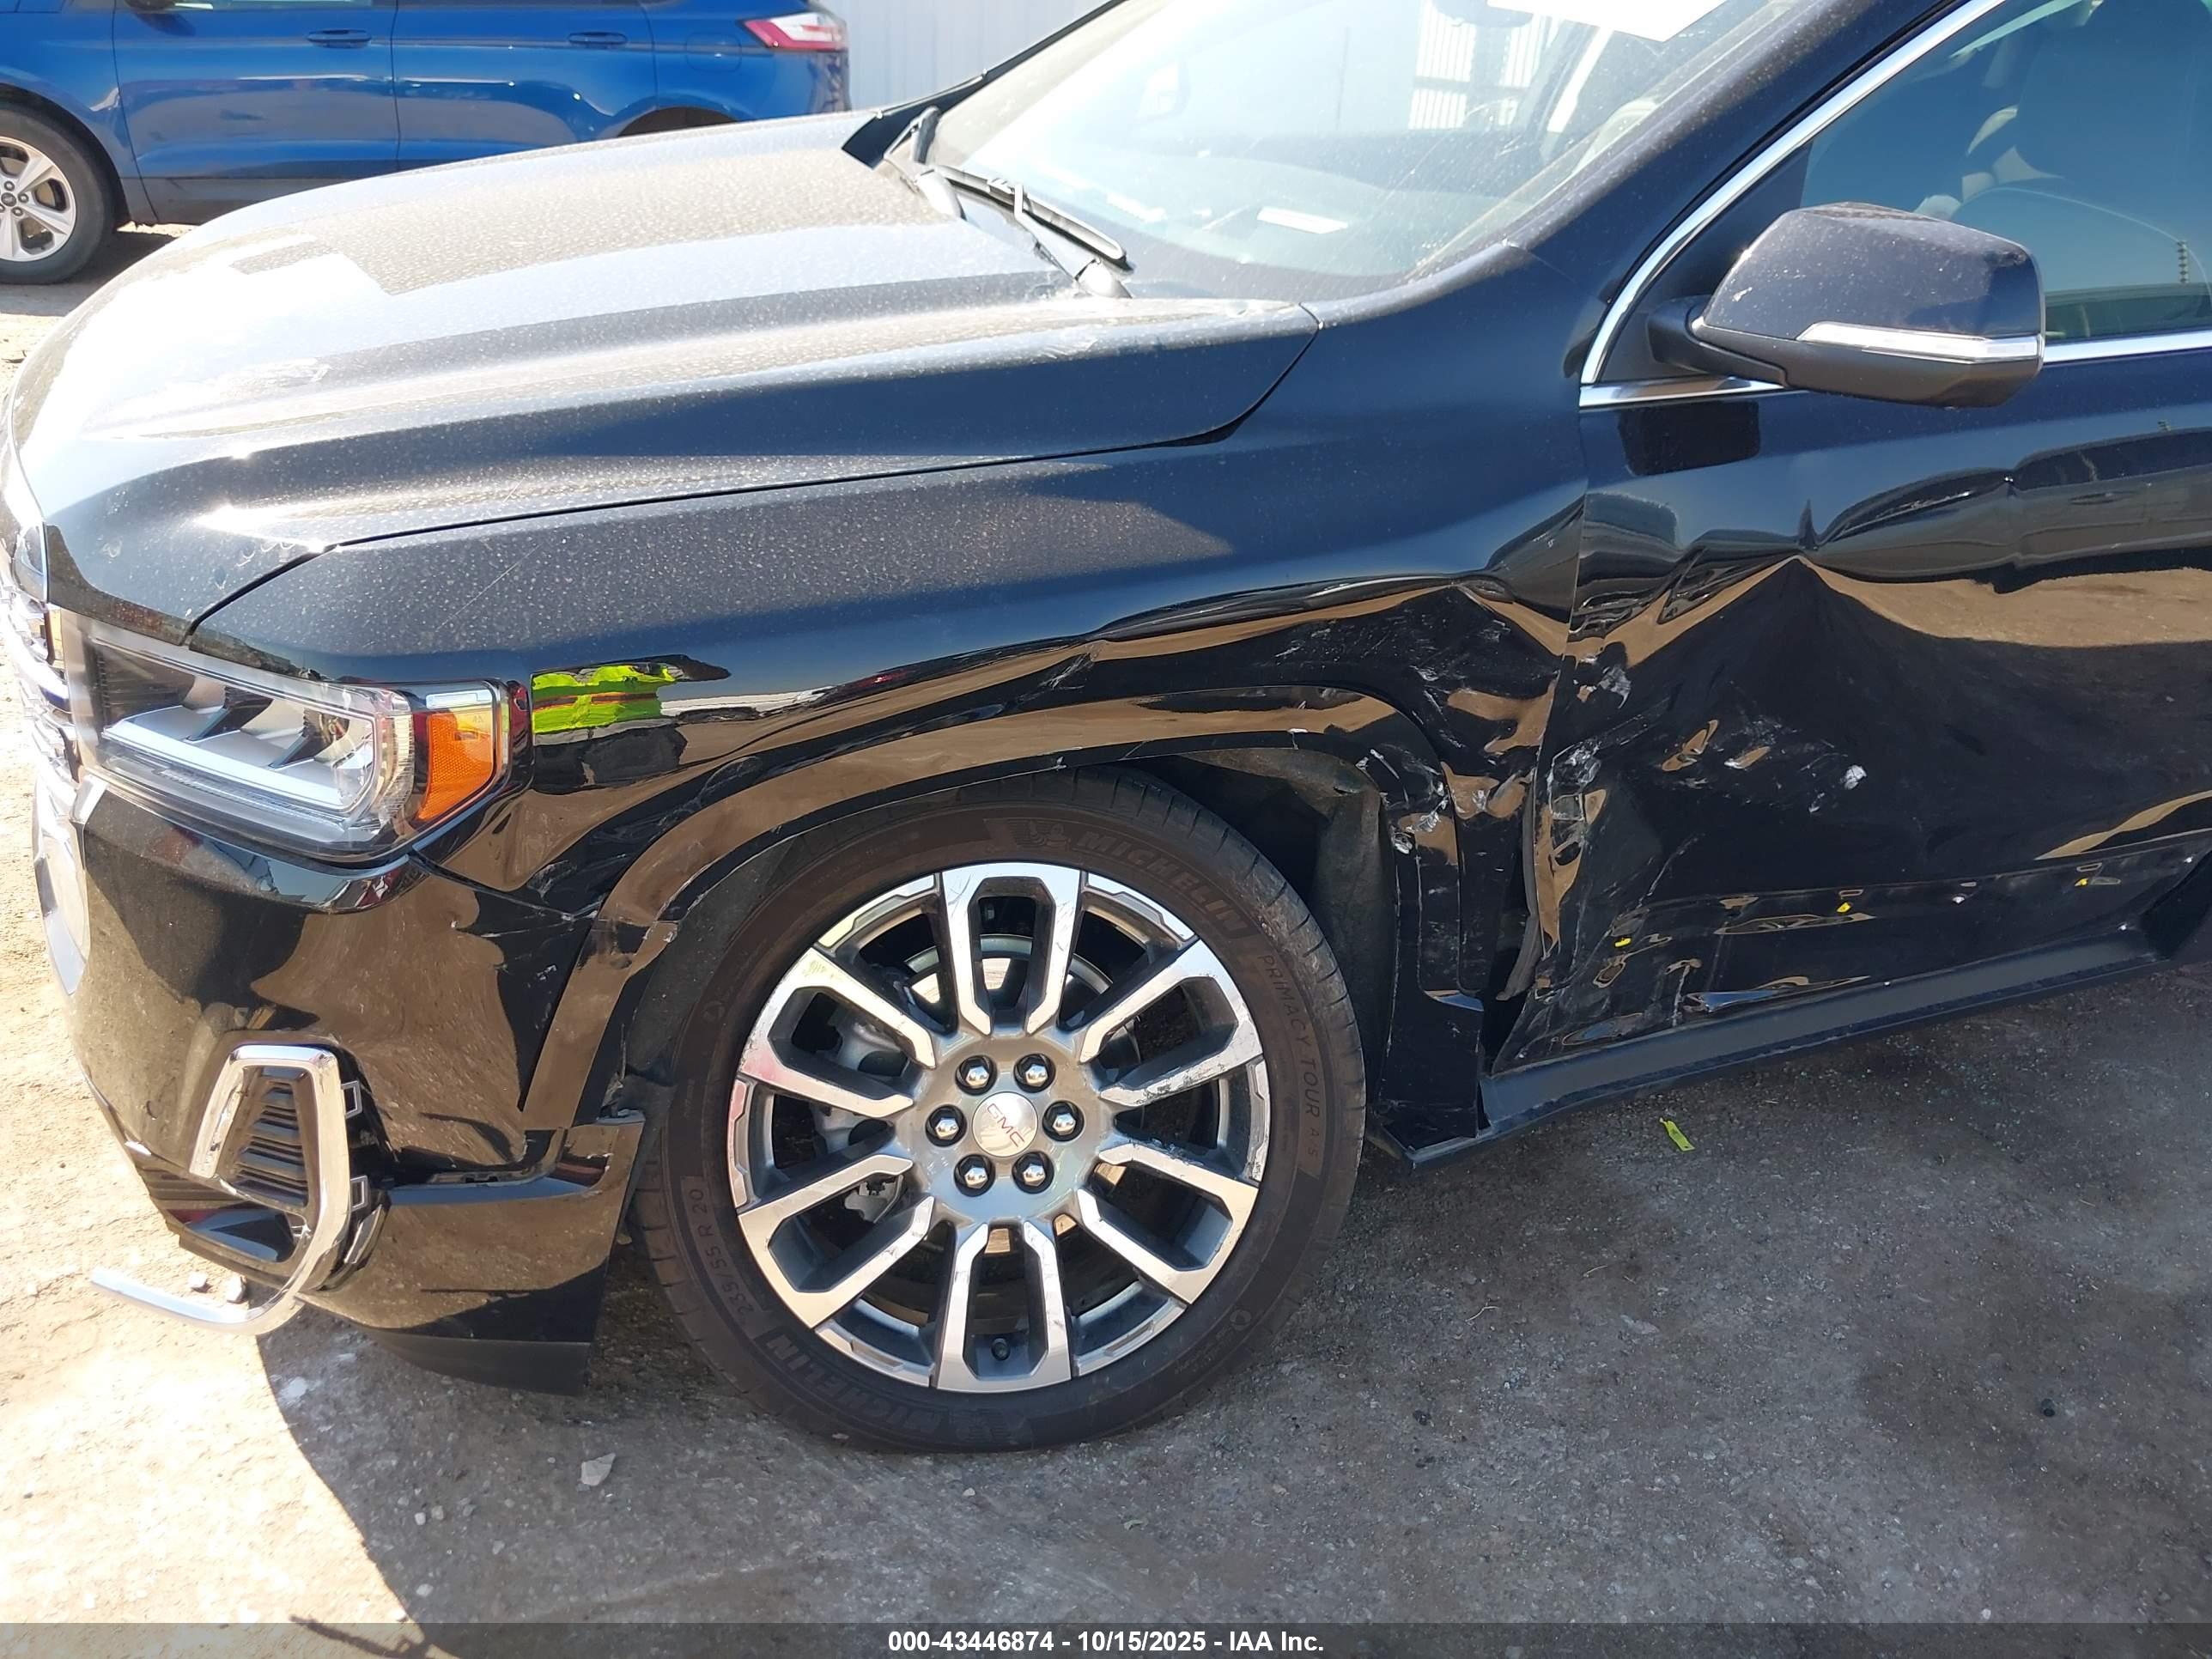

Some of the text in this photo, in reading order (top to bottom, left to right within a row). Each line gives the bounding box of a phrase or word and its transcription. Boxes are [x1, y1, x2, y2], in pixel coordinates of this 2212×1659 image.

[1076, 830, 1248, 933] MICHELIN
[1256, 953, 1312, 1048] PRIMACY
[1300, 1056, 1321, 1117] TOUR
[988, 1103, 1025, 1147] GMC
[688, 1188, 755, 1317] 235/55 R 20
